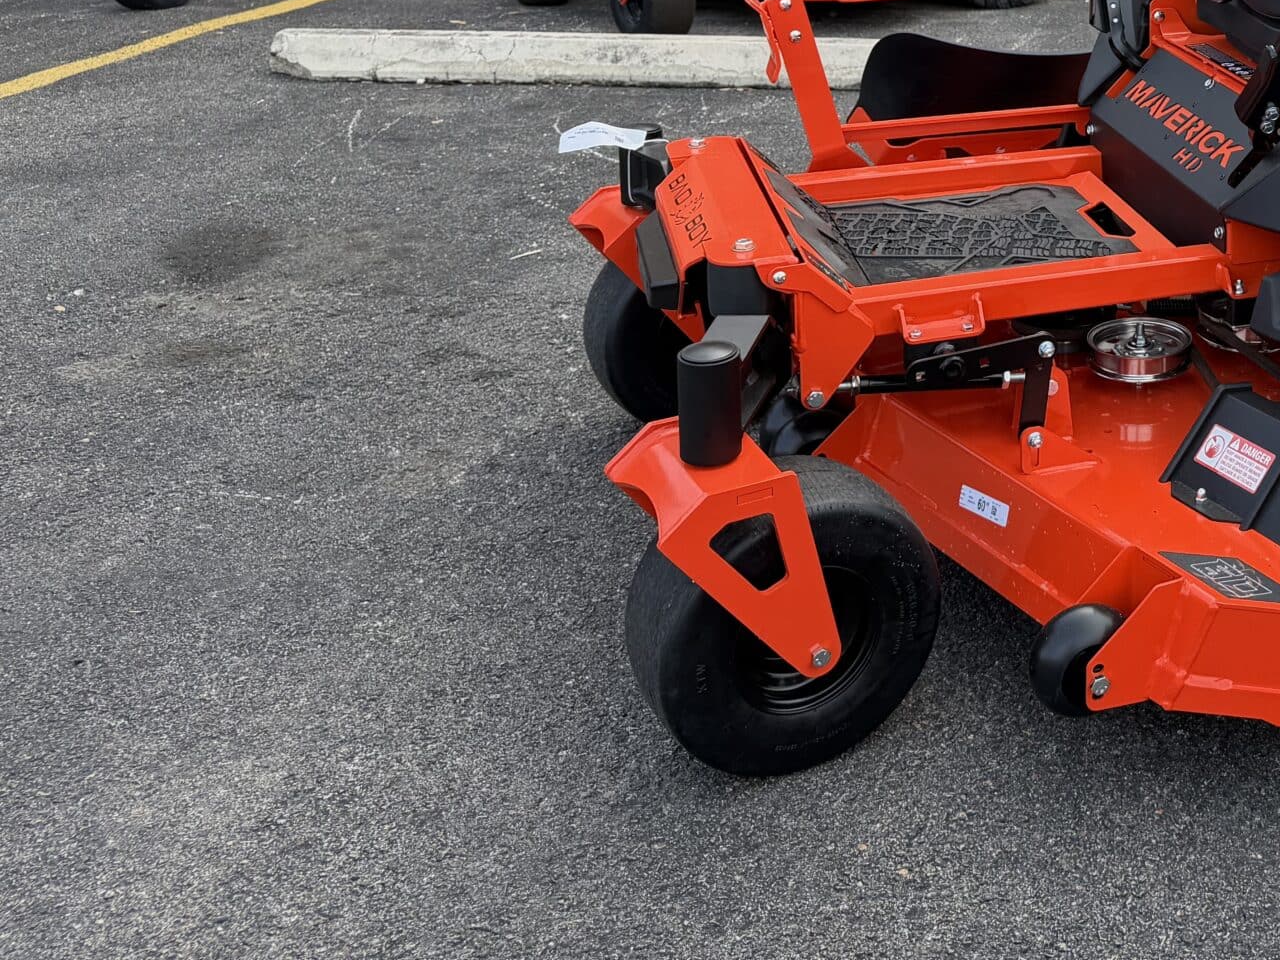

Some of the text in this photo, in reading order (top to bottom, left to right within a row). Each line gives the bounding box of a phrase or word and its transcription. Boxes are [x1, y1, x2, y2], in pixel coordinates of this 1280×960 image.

[1125, 79, 1245, 169] MAVERICK
[1172, 147, 1204, 173] HD
[685, 214, 713, 249] BOY
[1240, 443, 1272, 465] DANGER
